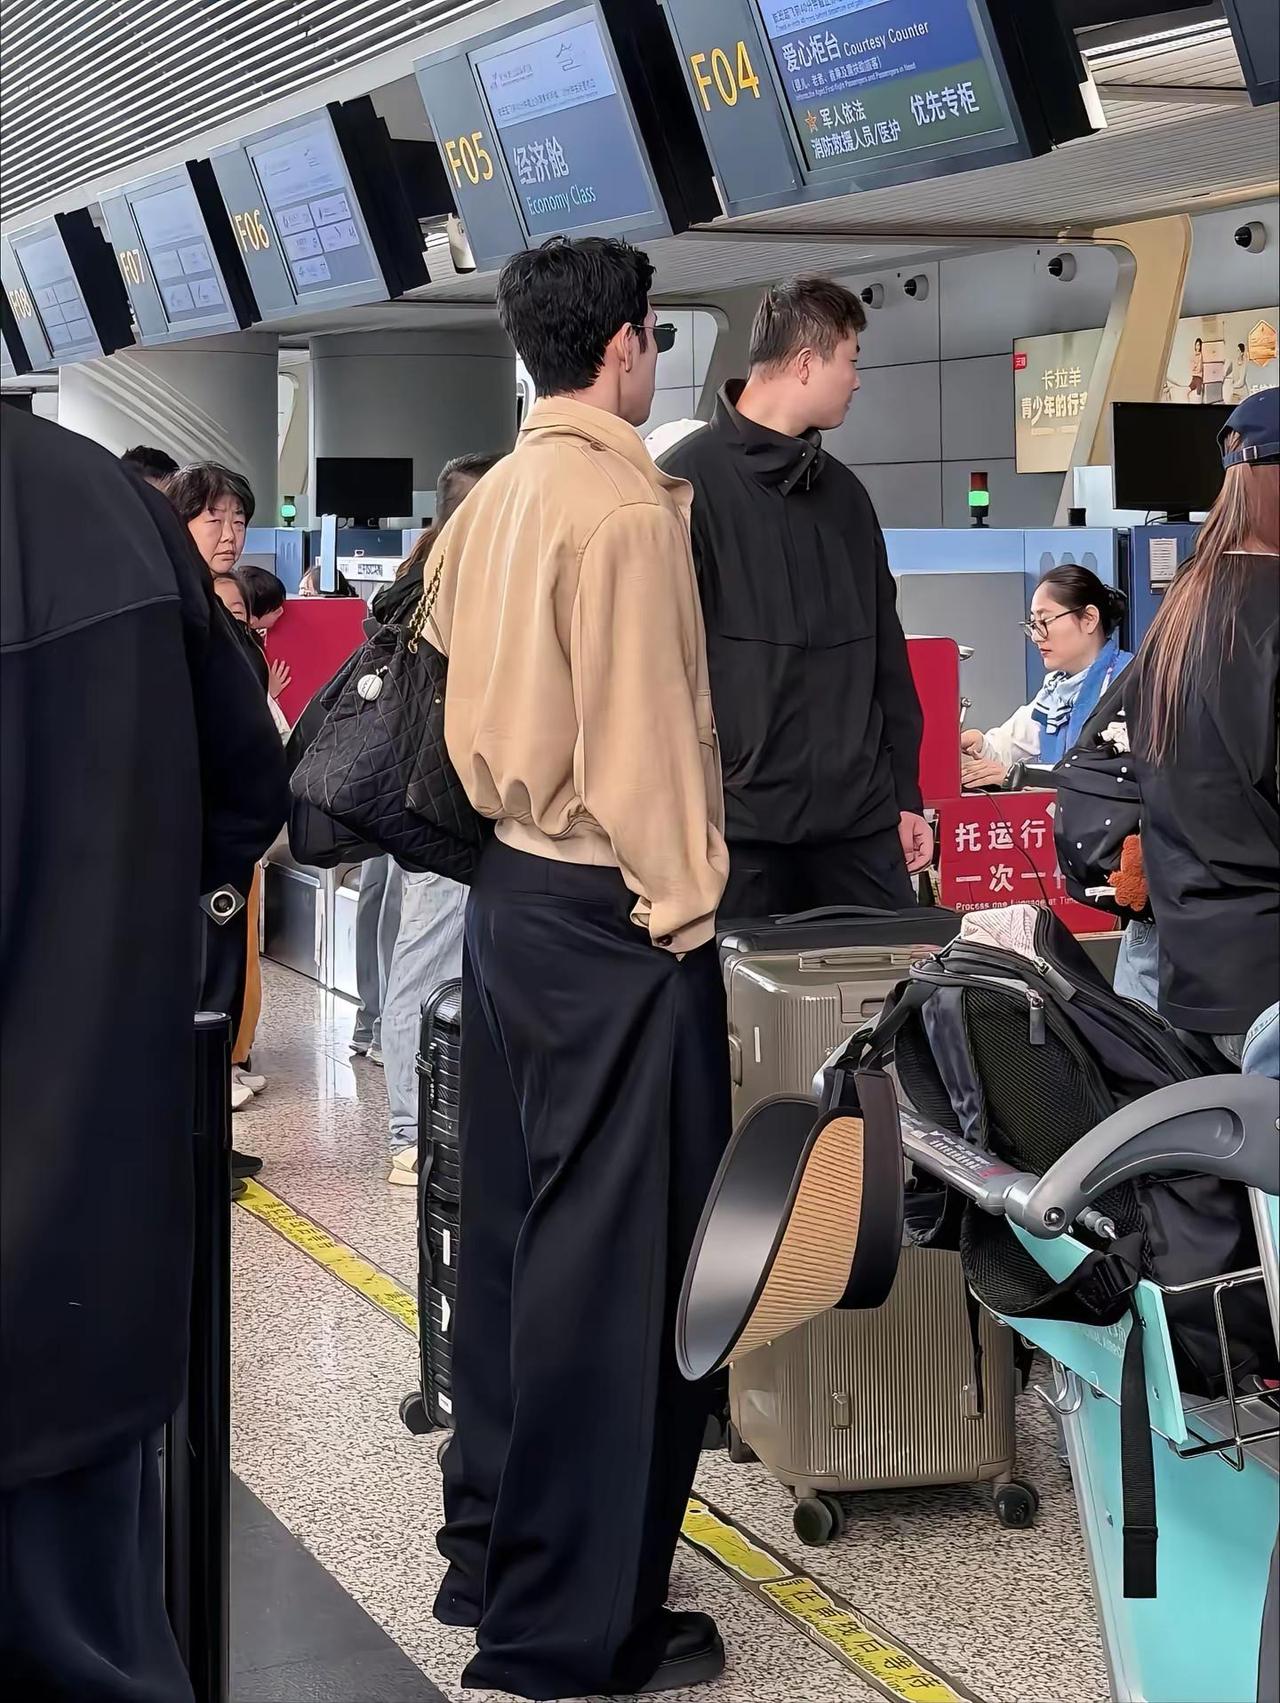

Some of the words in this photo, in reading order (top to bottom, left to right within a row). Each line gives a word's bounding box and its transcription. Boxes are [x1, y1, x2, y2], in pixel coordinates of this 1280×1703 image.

[783, 30, 841, 73] 爱心柜台
[843, 35, 886, 57] Courtesy
[888, 22, 929, 44] Counter
[690, 41, 760, 111] F04
[819, 99, 867, 129] 军人依法
[909, 81, 980, 126] 优先专柜
[811, 118, 902, 160] 消防救援人员/医护
[445, 131, 494, 189] F05
[513, 135, 570, 185] 经济舱
[526, 191, 571, 215] Economy
[570, 184, 597, 207] Class
[234, 209, 270, 253] F06
[120, 249, 146, 287] F07
[1041, 366, 1082, 391] 卡拉羊
[955, 819, 1047, 852] 托运行
[956, 902, 990, 911] Process
[850, 1652, 883, 1678] Yellow
